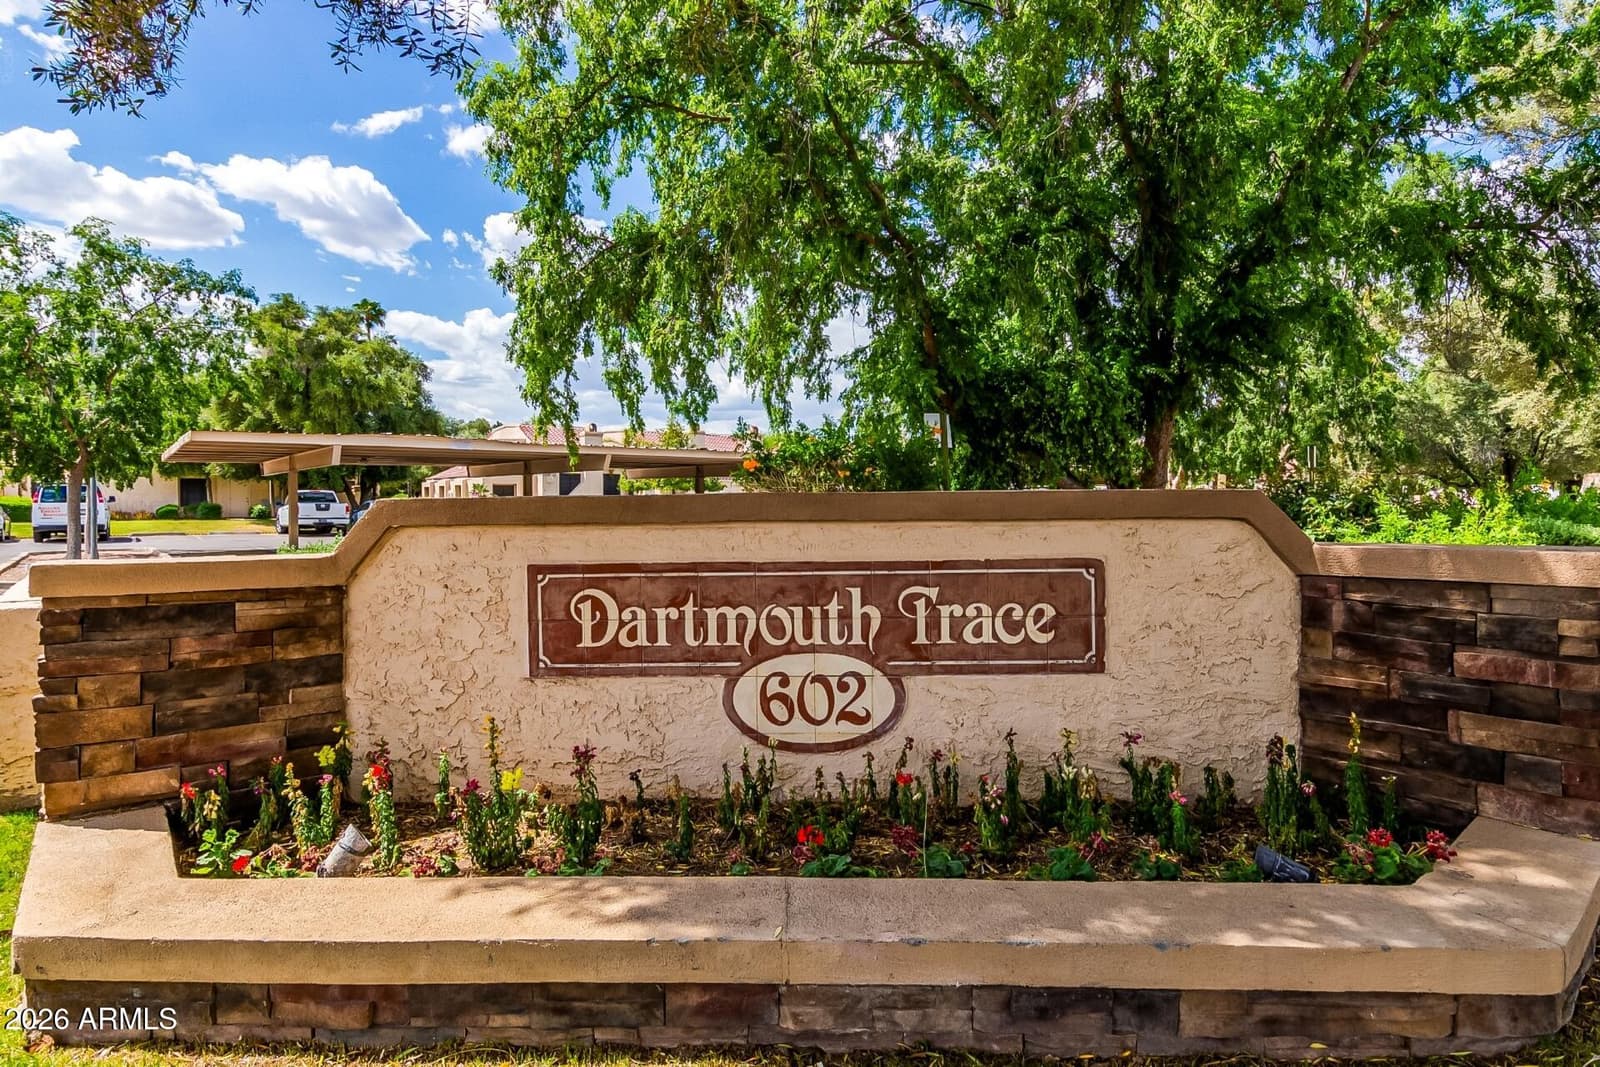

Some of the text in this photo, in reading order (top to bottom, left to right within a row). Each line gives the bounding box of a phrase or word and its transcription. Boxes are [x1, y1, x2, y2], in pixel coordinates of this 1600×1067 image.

[569, 585, 1057, 656] Dartmouth Trace
[759, 670, 872, 727] 602
